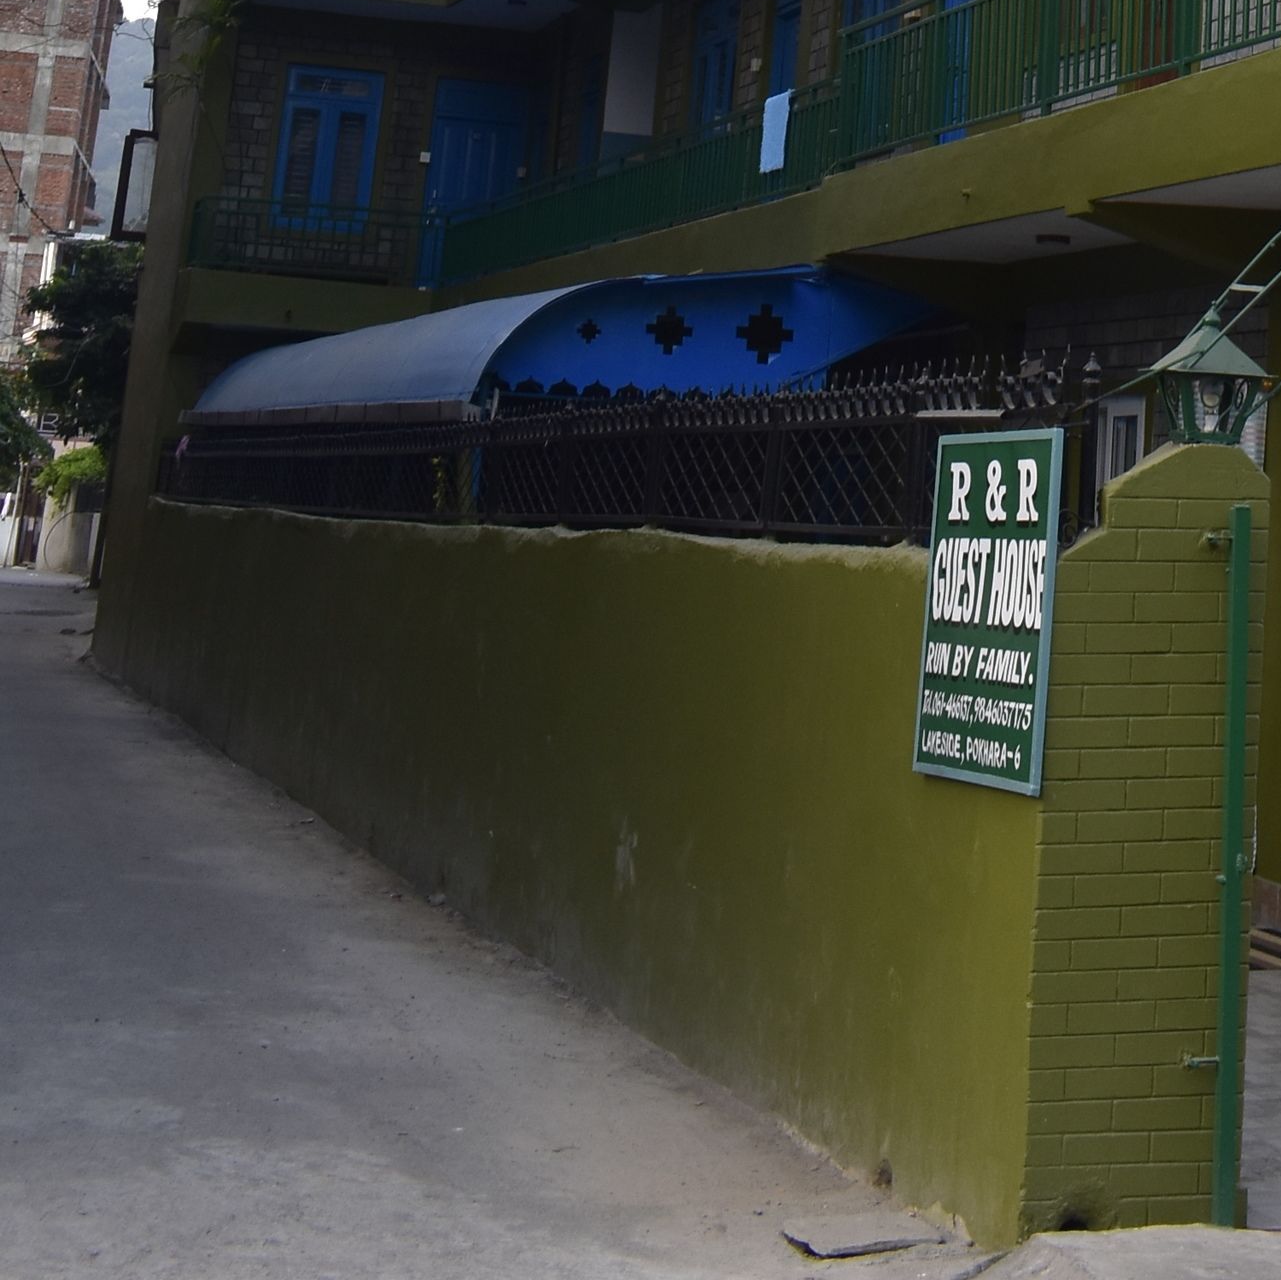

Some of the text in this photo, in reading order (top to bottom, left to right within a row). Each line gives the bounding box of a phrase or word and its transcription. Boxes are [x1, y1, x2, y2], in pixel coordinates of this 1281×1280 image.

[948, 458, 1039, 522] R & R
[932, 538, 1047, 630] GUEST HOUSE
[925, 641, 1034, 685] RUN BY FAMILY.
[922, 728, 965, 765] LAKESIDE,
